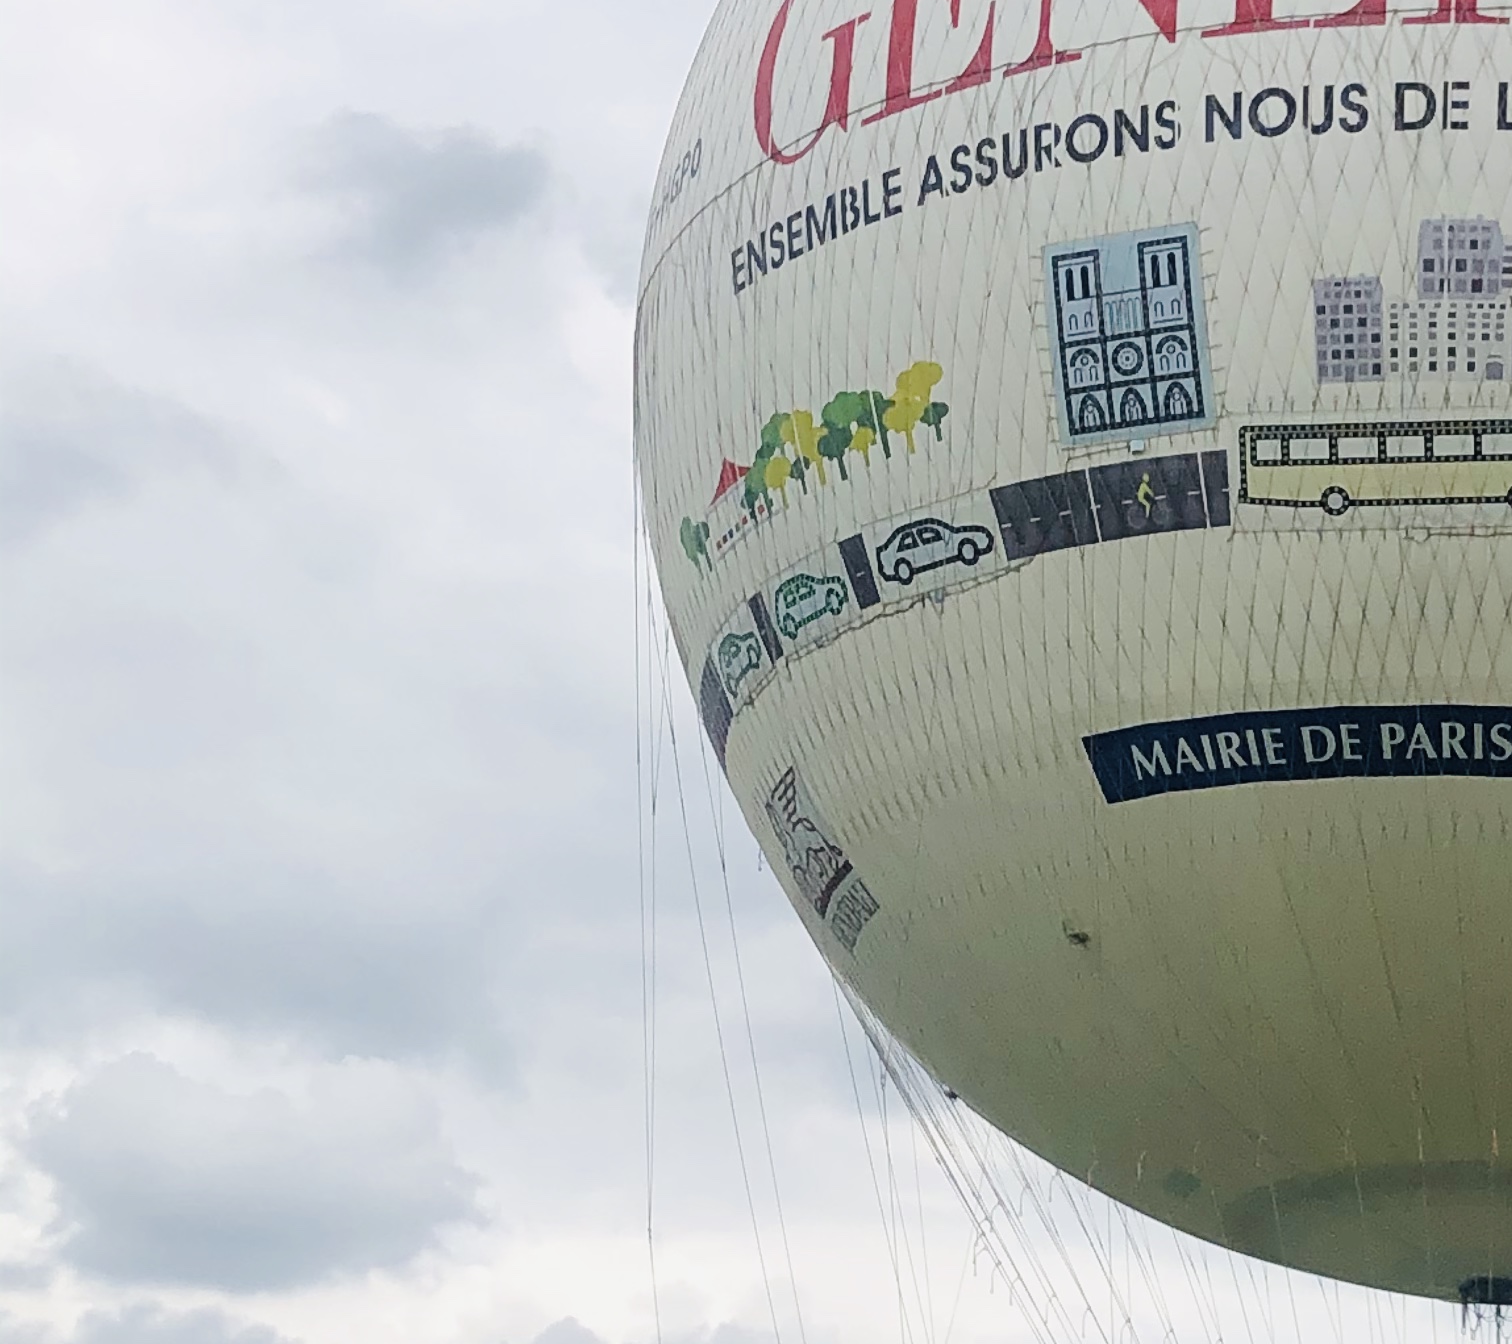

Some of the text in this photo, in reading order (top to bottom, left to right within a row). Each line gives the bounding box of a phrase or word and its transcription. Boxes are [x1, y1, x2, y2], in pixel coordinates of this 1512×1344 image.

[731, 167, 903, 294] ENSEMBLE
[917, 100, 1181, 206] ASSURONS
[1204, 83, 1368, 142] NOUS
[1394, 81, 1470, 131] DE
[1130, 721, 1512, 782] MAIRIE DE PARIS
